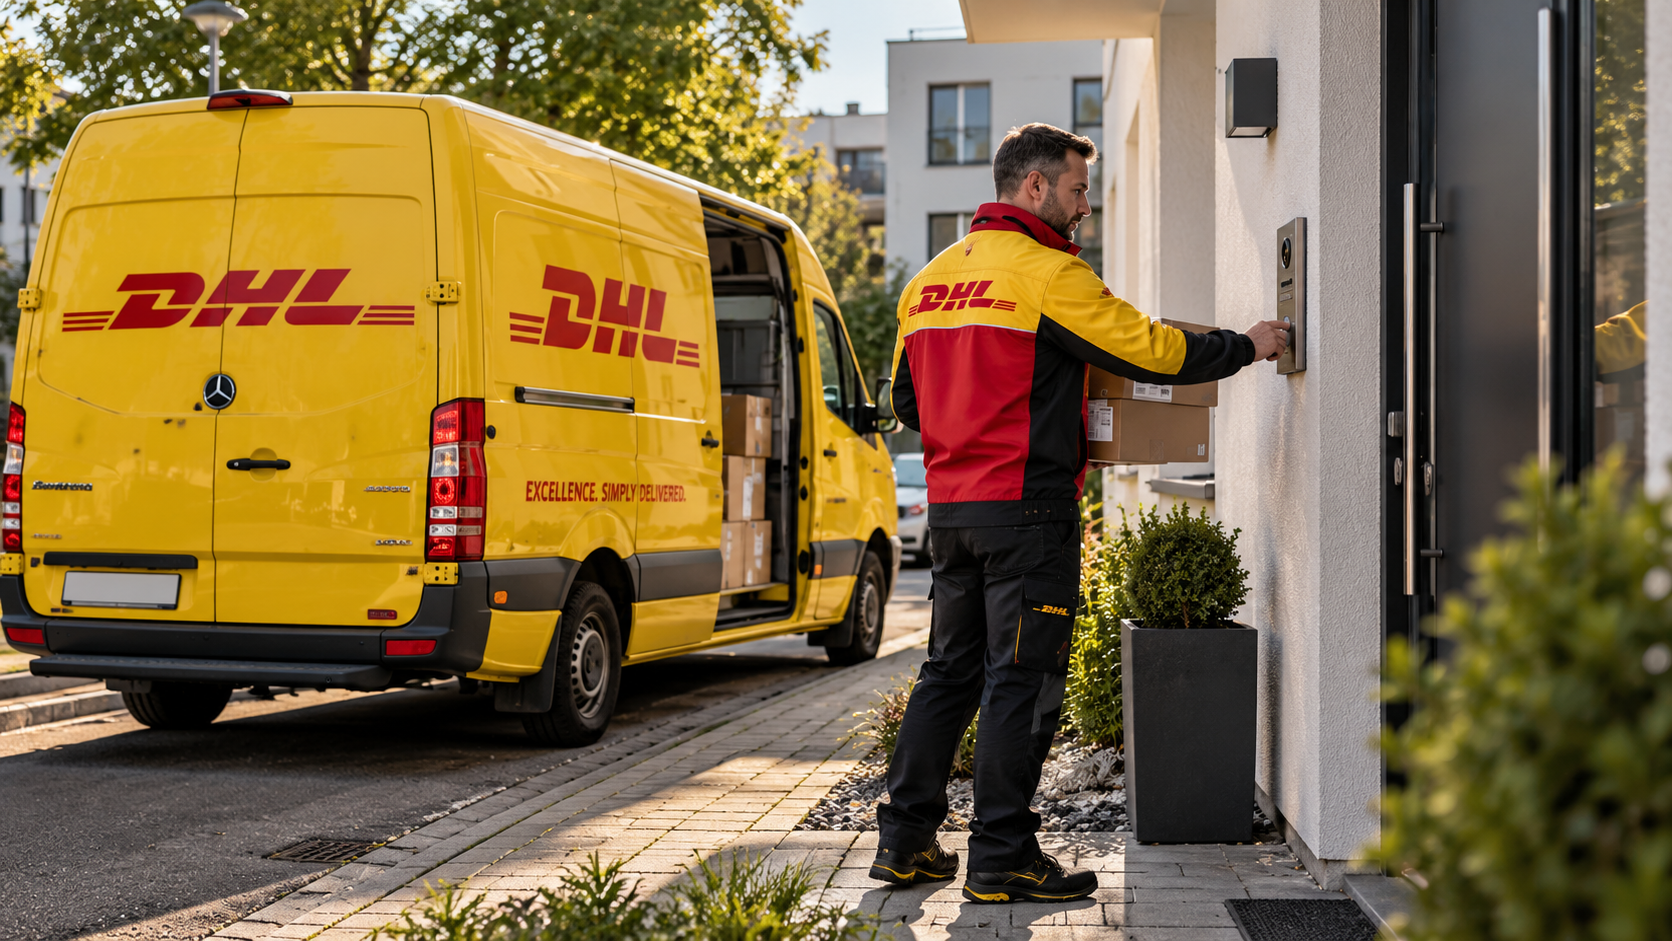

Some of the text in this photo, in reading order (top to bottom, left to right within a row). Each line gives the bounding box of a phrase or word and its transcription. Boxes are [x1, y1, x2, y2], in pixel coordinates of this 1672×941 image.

[108, 268, 364, 329] DHL
[917, 280, 996, 313] DHL
[542, 264, 677, 363] DHL
[525, 481, 686, 502] EXCELLENCE. SIMPLY DELIVERED.
[1041, 604, 1070, 616] DHL
